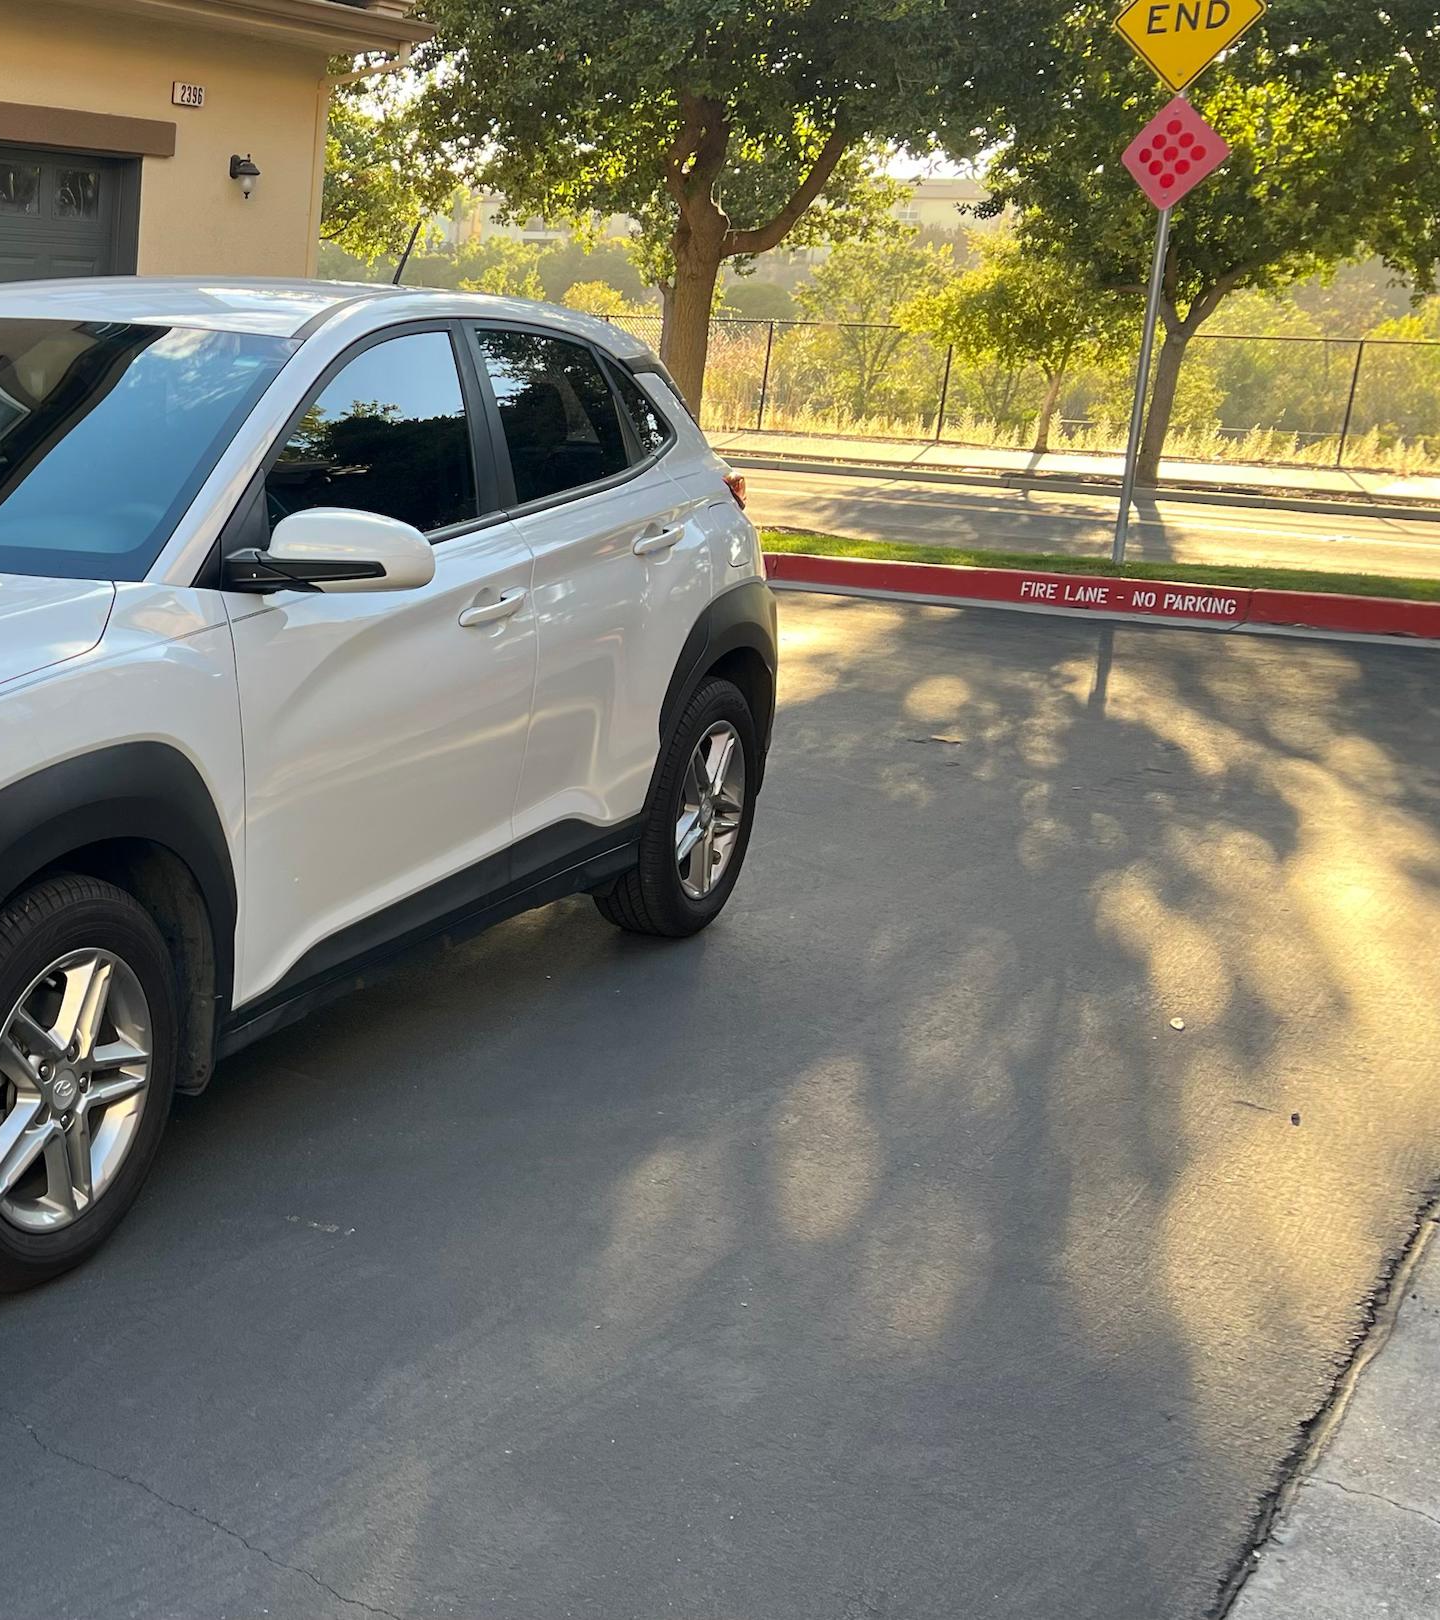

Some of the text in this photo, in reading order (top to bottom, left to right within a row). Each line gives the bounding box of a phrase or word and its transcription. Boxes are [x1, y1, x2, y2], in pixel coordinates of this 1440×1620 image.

[1147, 0, 1230, 34] END
[181, 85, 203, 104] 2396
[1020, 581, 1058, 600] FIRE
[1064, 585, 1109, 604] LANE
[1132, 591, 1156, 608] NO
[1163, 593, 1237, 615] PARKING
